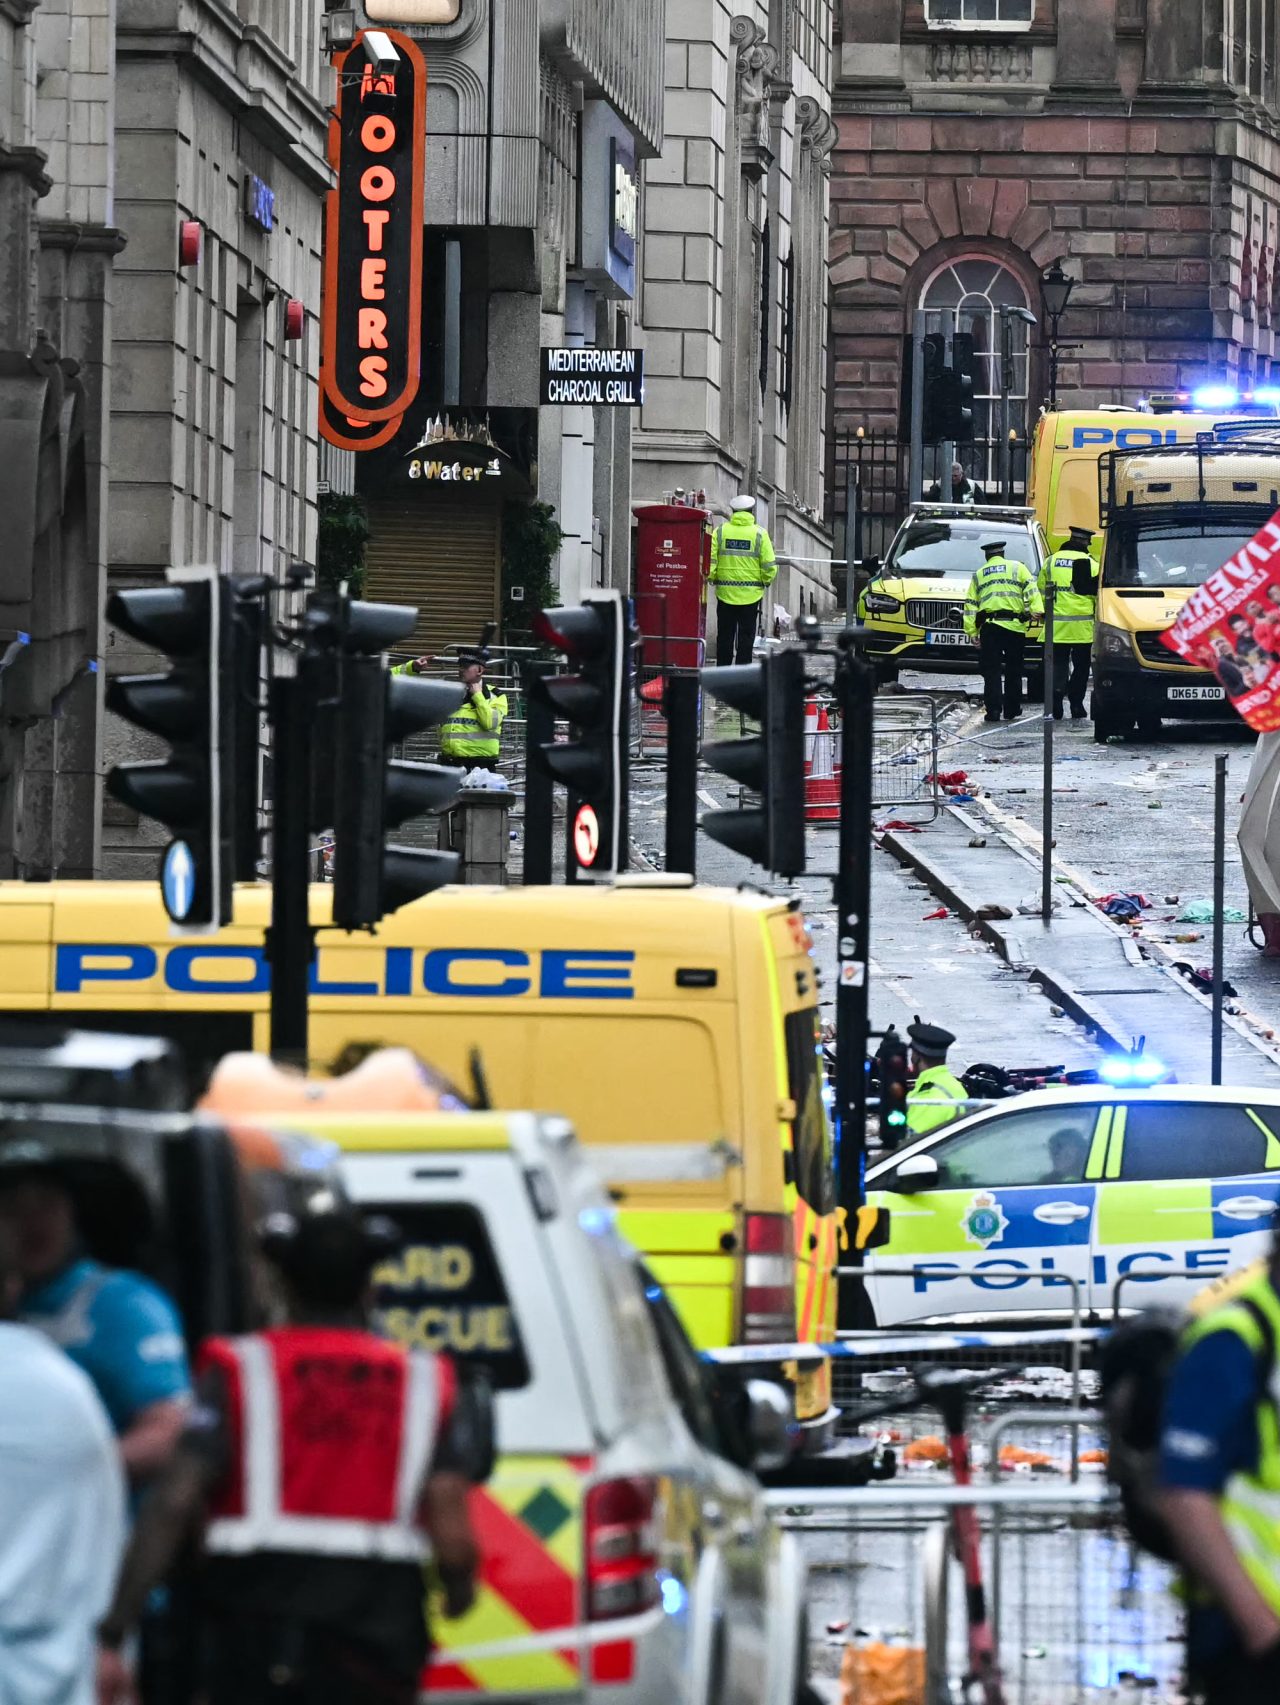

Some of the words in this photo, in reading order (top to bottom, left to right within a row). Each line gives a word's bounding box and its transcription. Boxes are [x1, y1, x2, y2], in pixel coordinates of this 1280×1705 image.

[548, 349, 635, 372] MEDITERRANEAN
[548, 380, 604, 402] CHARCOAL
[606, 380, 635, 402] GRILL
[409, 459, 421, 479] 8
[424, 460, 483, 481] Water
[726, 540, 750, 549] POLICE
[983, 565, 1005, 576] POLICE
[934, 634, 956, 644] AD16
[958, 635, 974, 645] FU
[1172, 689, 1198, 698] DK65
[55, 943, 635, 998] POLICE
[912, 1248, 1231, 1293] POLICE
[384, 1306, 513, 1352] SCUE
